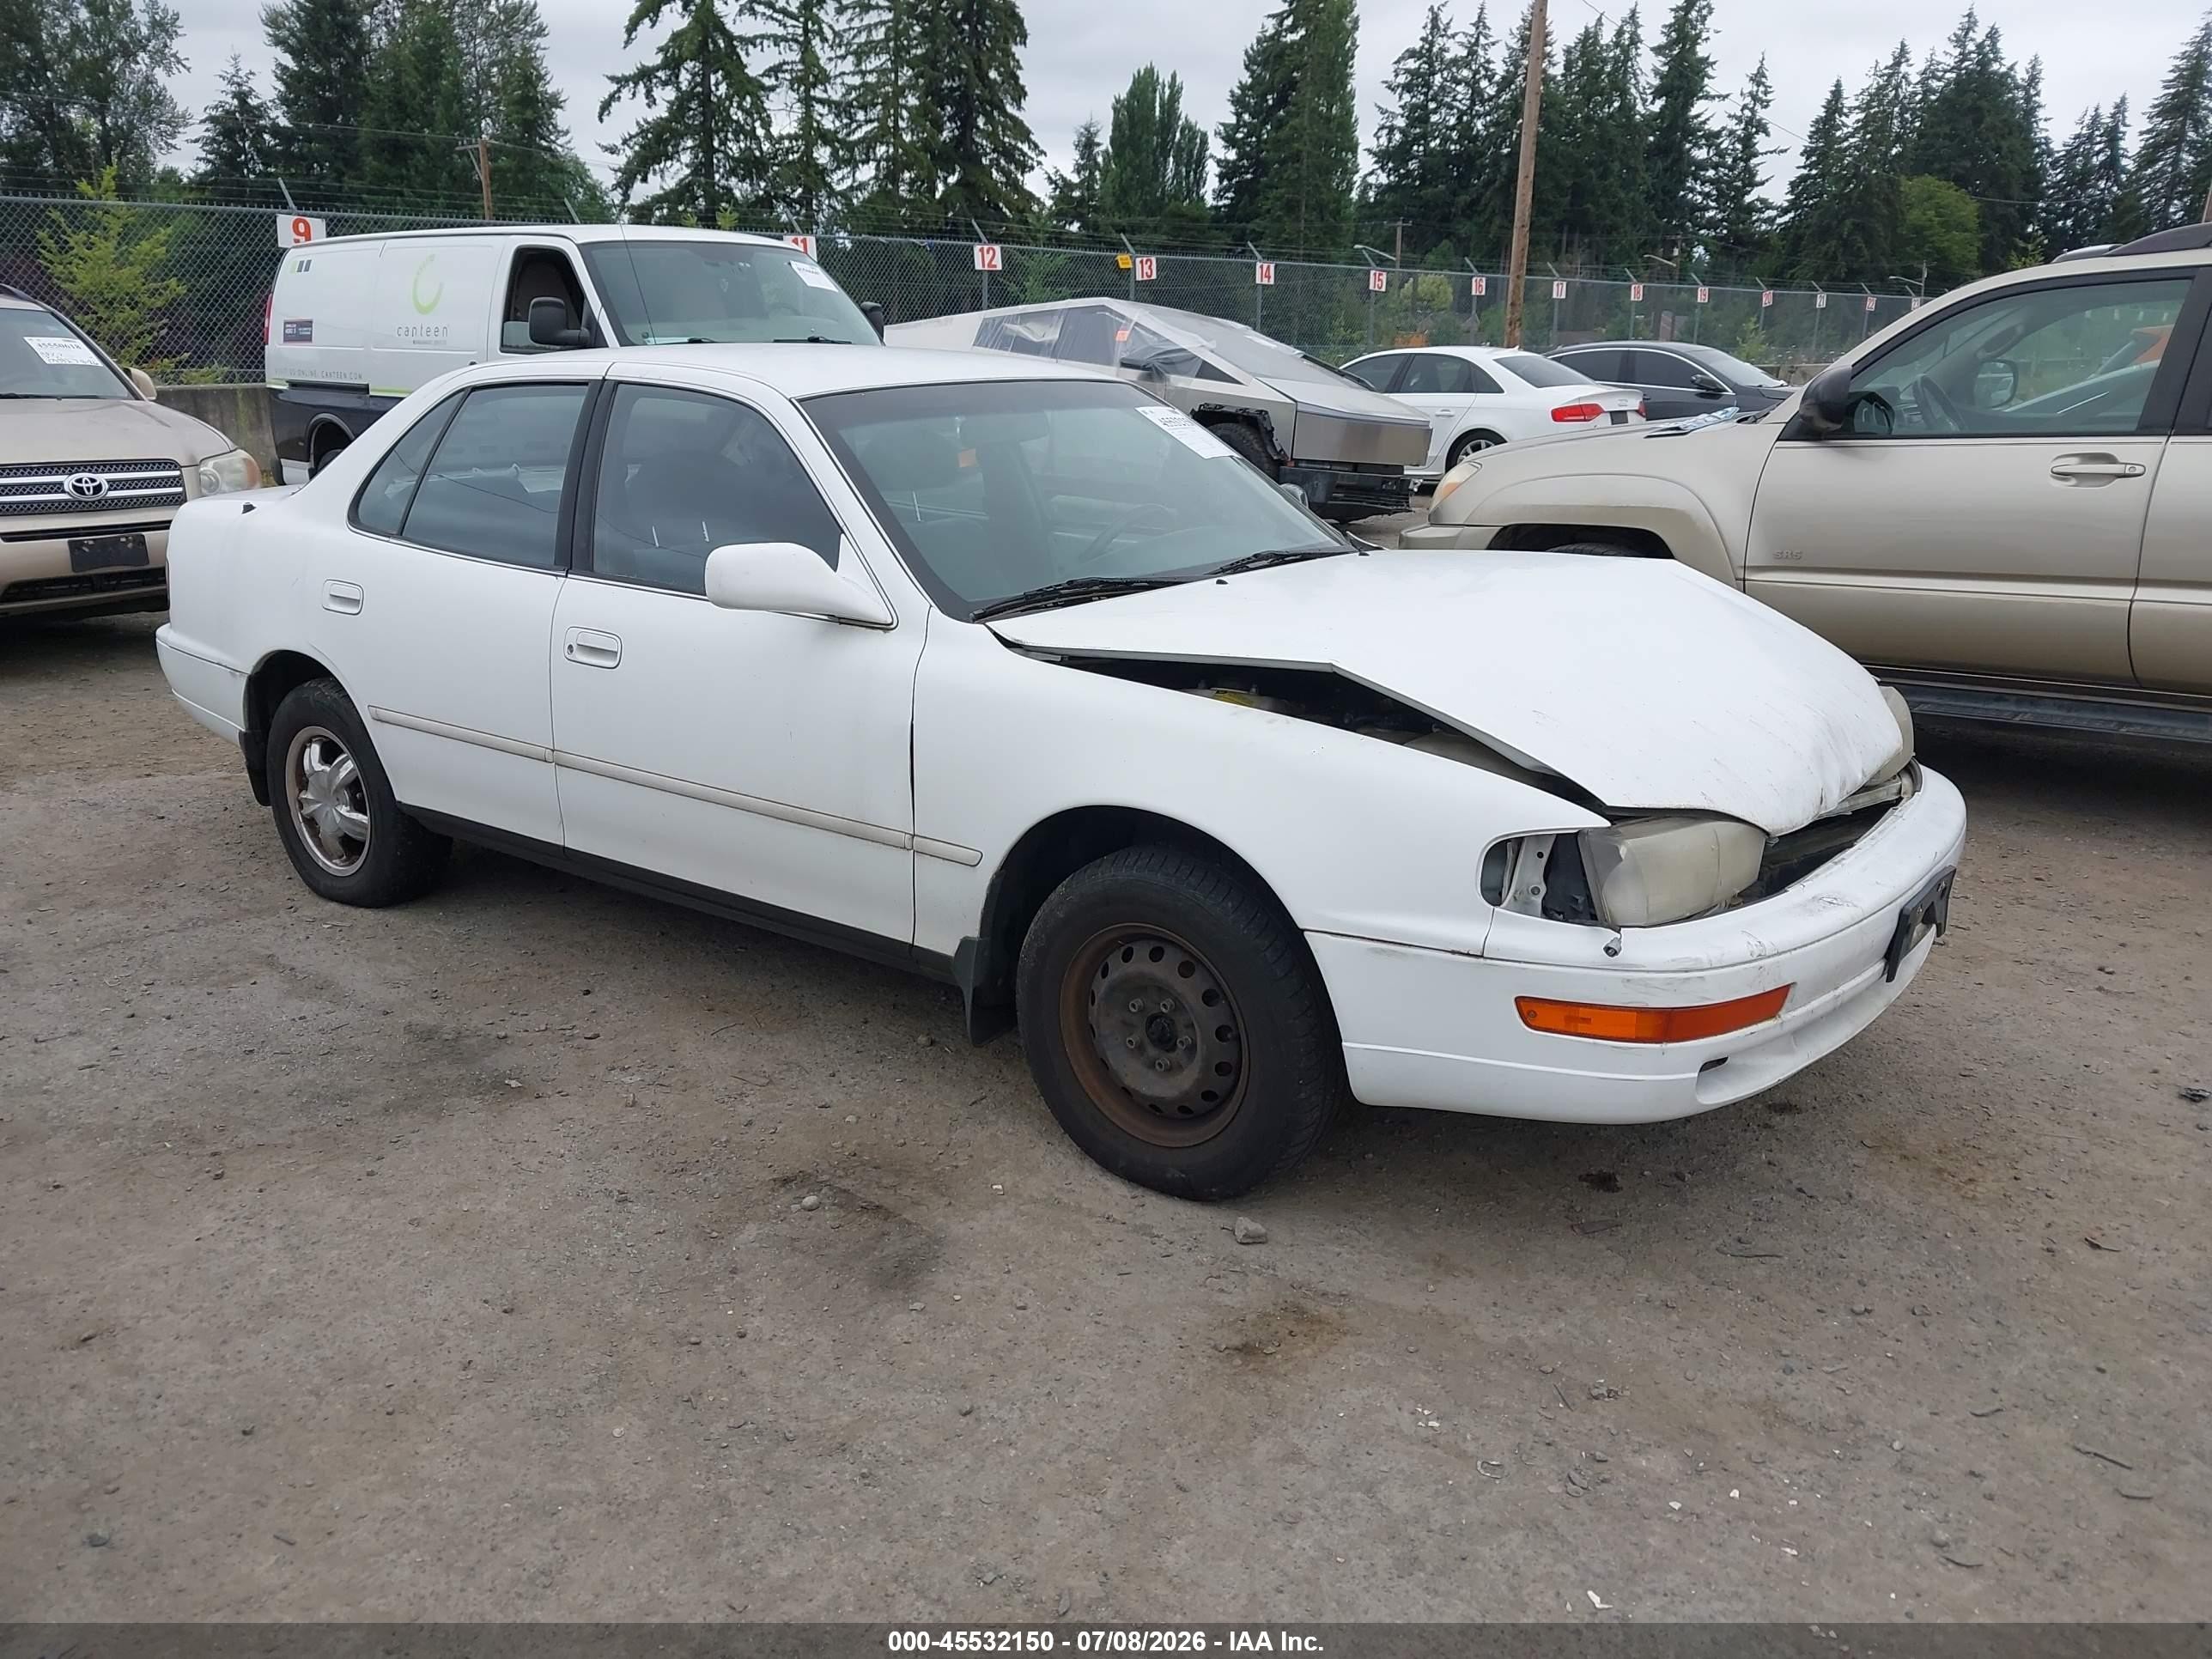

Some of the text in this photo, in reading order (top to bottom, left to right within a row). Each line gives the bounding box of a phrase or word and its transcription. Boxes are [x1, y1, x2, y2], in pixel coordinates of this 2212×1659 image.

[292, 217, 312, 244] 9
[792, 237, 808, 254] 11
[978, 246, 997, 269] 12
[1139, 258, 1153, 279] 13
[1259, 264, 1272, 283] 14
[1372, 271, 1383, 290] 15
[1474, 277, 1484, 295] 16
[1555, 282, 1565, 297] 17
[1633, 284, 1642, 300] 18
[1698, 288, 1707, 302] 19
[1764, 291, 1772, 306] 20
[397, 323, 447, 337] canteen
